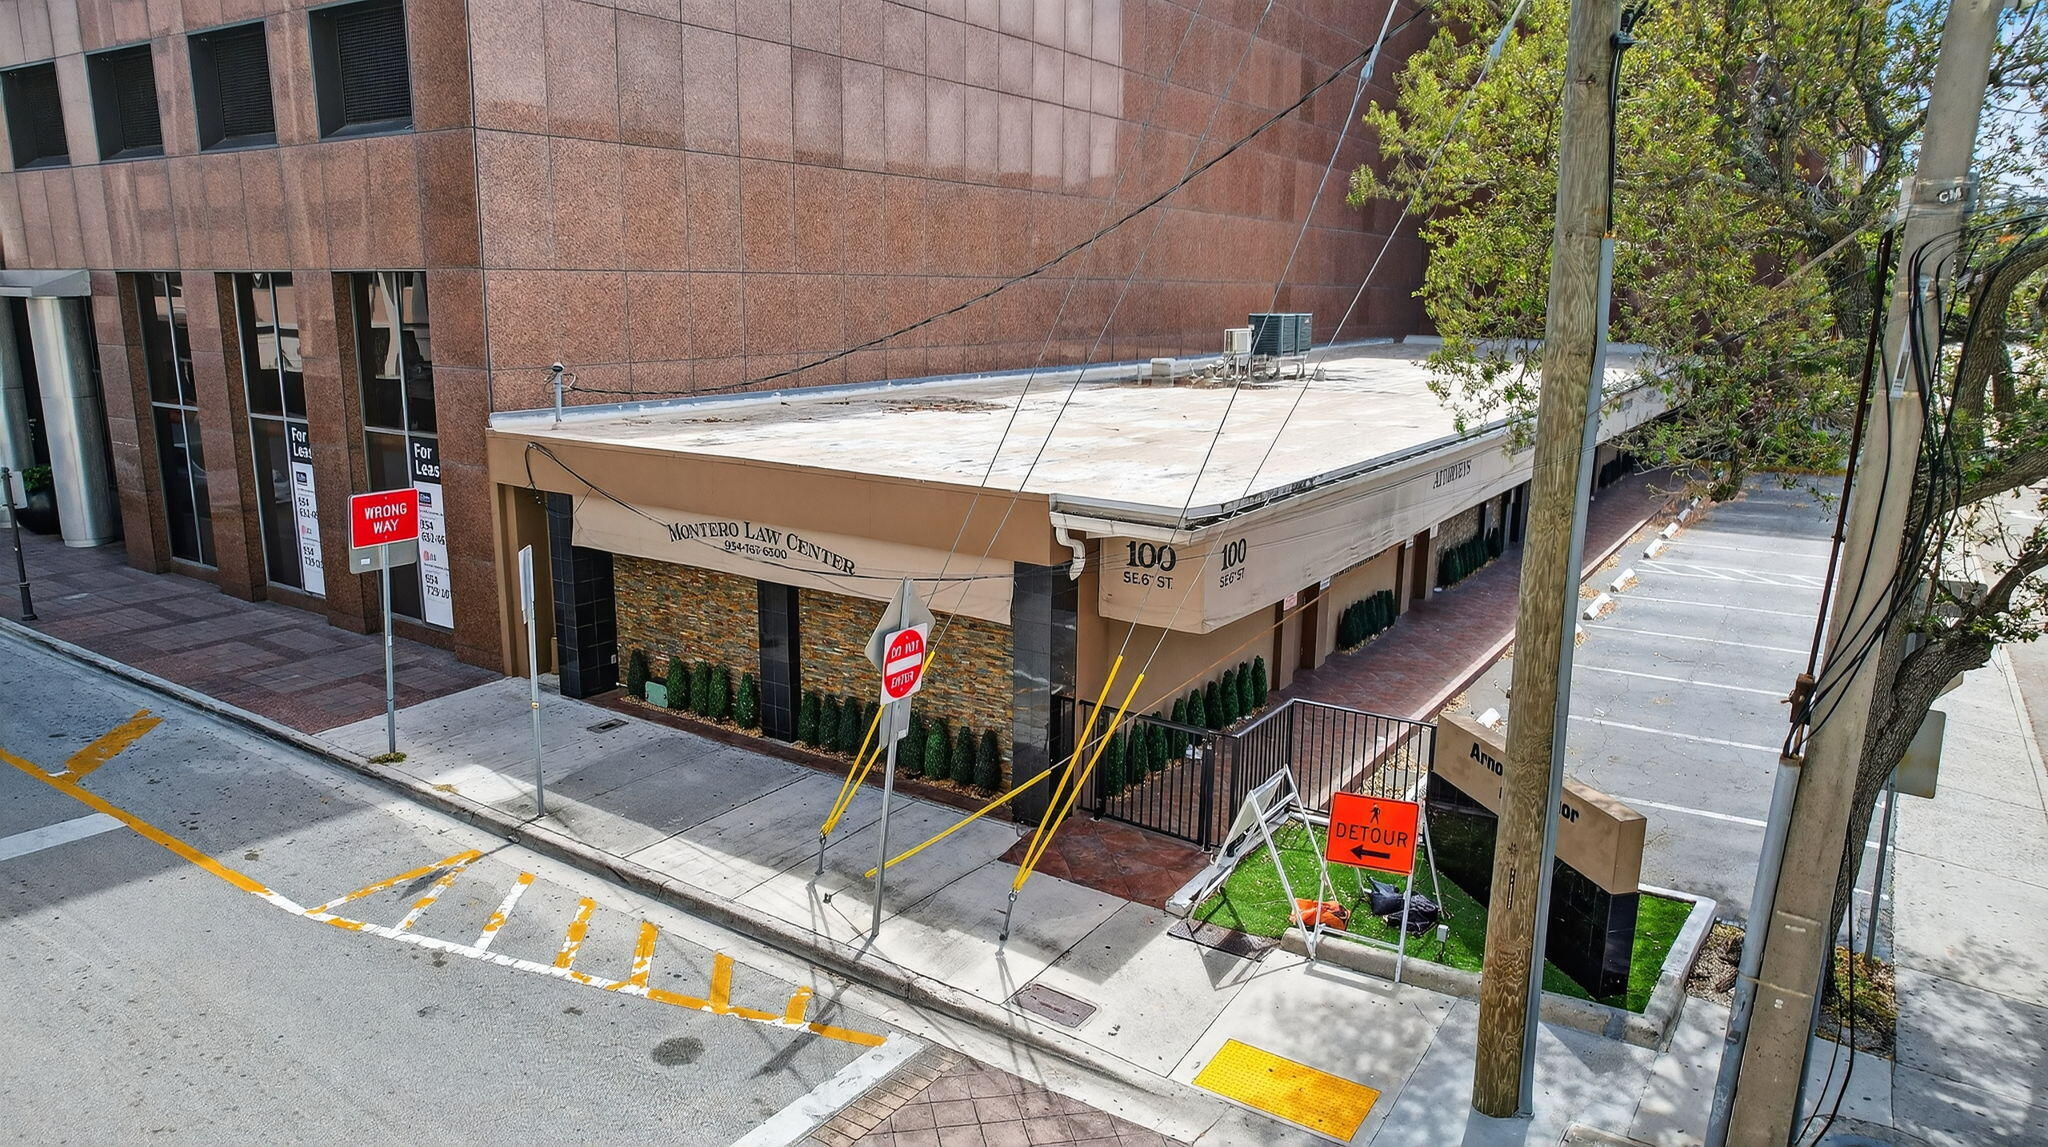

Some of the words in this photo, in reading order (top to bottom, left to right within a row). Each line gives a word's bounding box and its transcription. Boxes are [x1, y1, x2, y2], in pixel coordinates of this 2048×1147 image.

[291, 427, 307, 442] For
[414, 442, 433, 459] For
[364, 503, 408, 520] WRONG
[373, 518, 399, 535] WAY
[667, 522, 740, 543] MONTERO
[744, 521, 782, 546] LAW
[786, 533, 856, 576] CENTER
[1126, 540, 1177, 572] 100
[1220, 538, 1247, 572] 100
[1336, 822, 1408, 848] DETOUR
